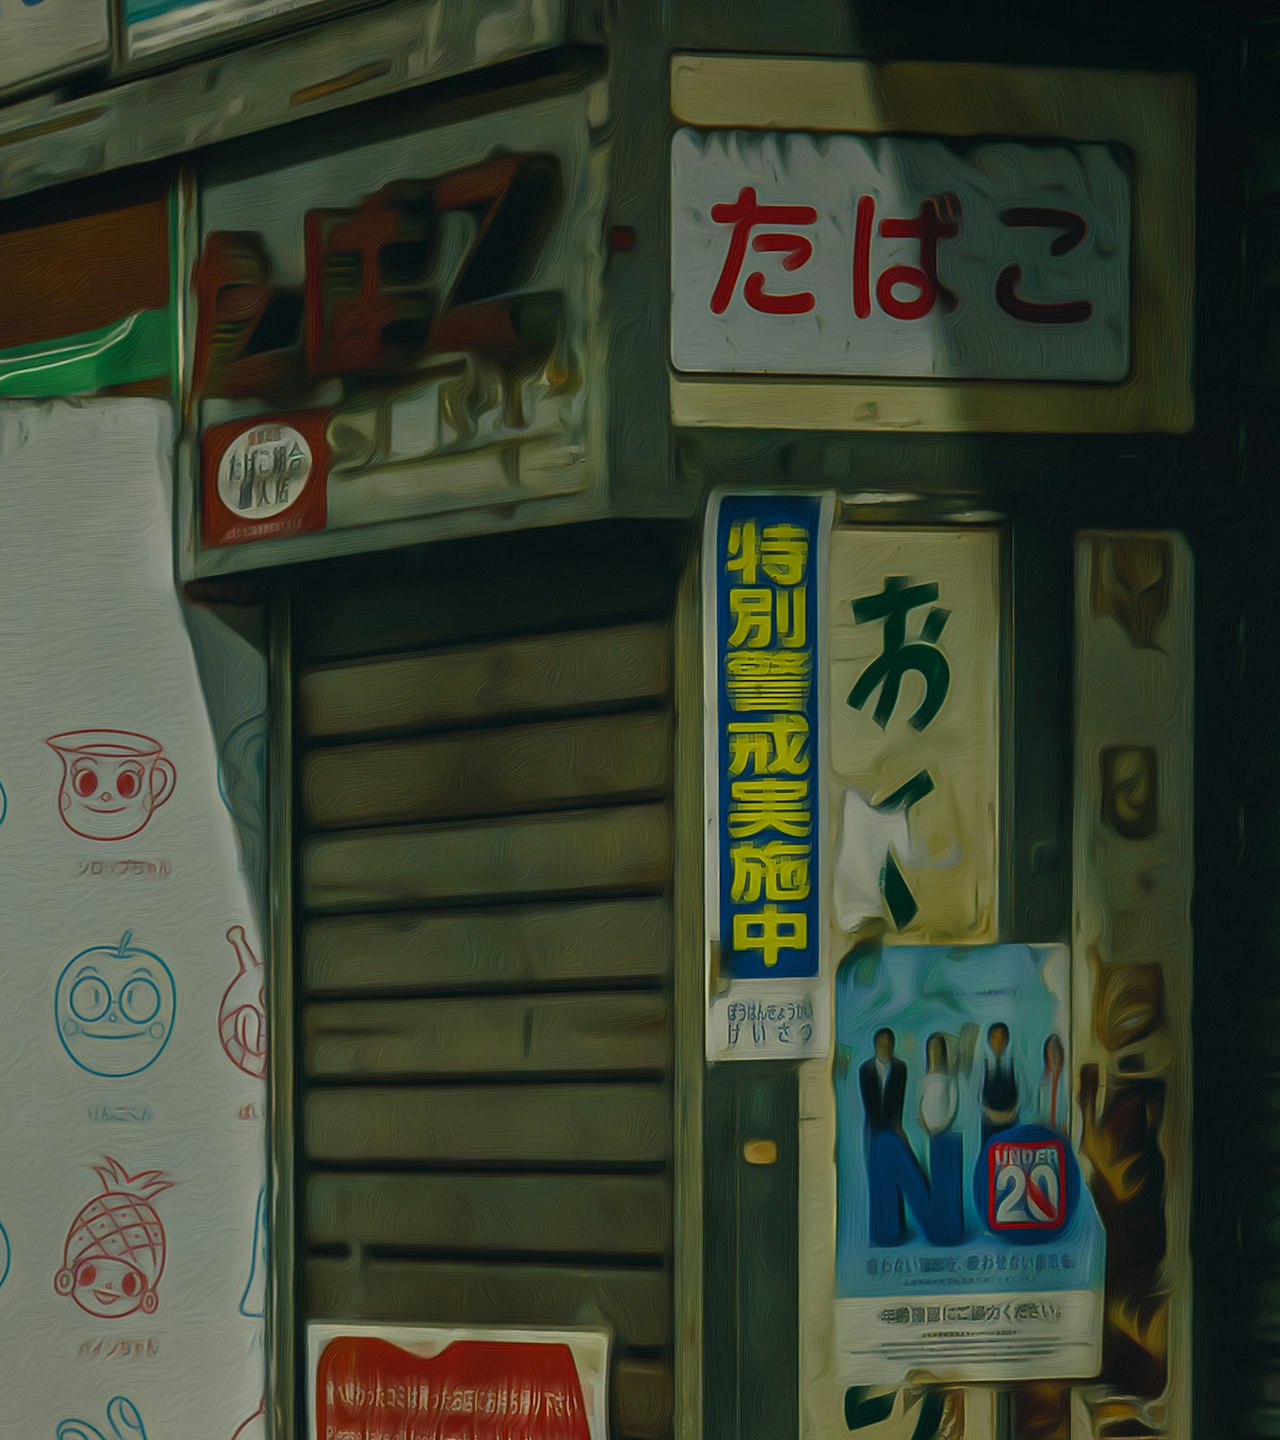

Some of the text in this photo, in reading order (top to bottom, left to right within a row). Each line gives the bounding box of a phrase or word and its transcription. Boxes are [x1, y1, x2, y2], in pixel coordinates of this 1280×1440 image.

[709, 185, 1093, 324] たばこ
[727, 520, 814, 968] 特別警戒実施中
[728, 1022, 813, 1044] けいさつ
[994, 1148, 1059, 1165] UNDER
[996, 1164, 1059, 1223] 20
